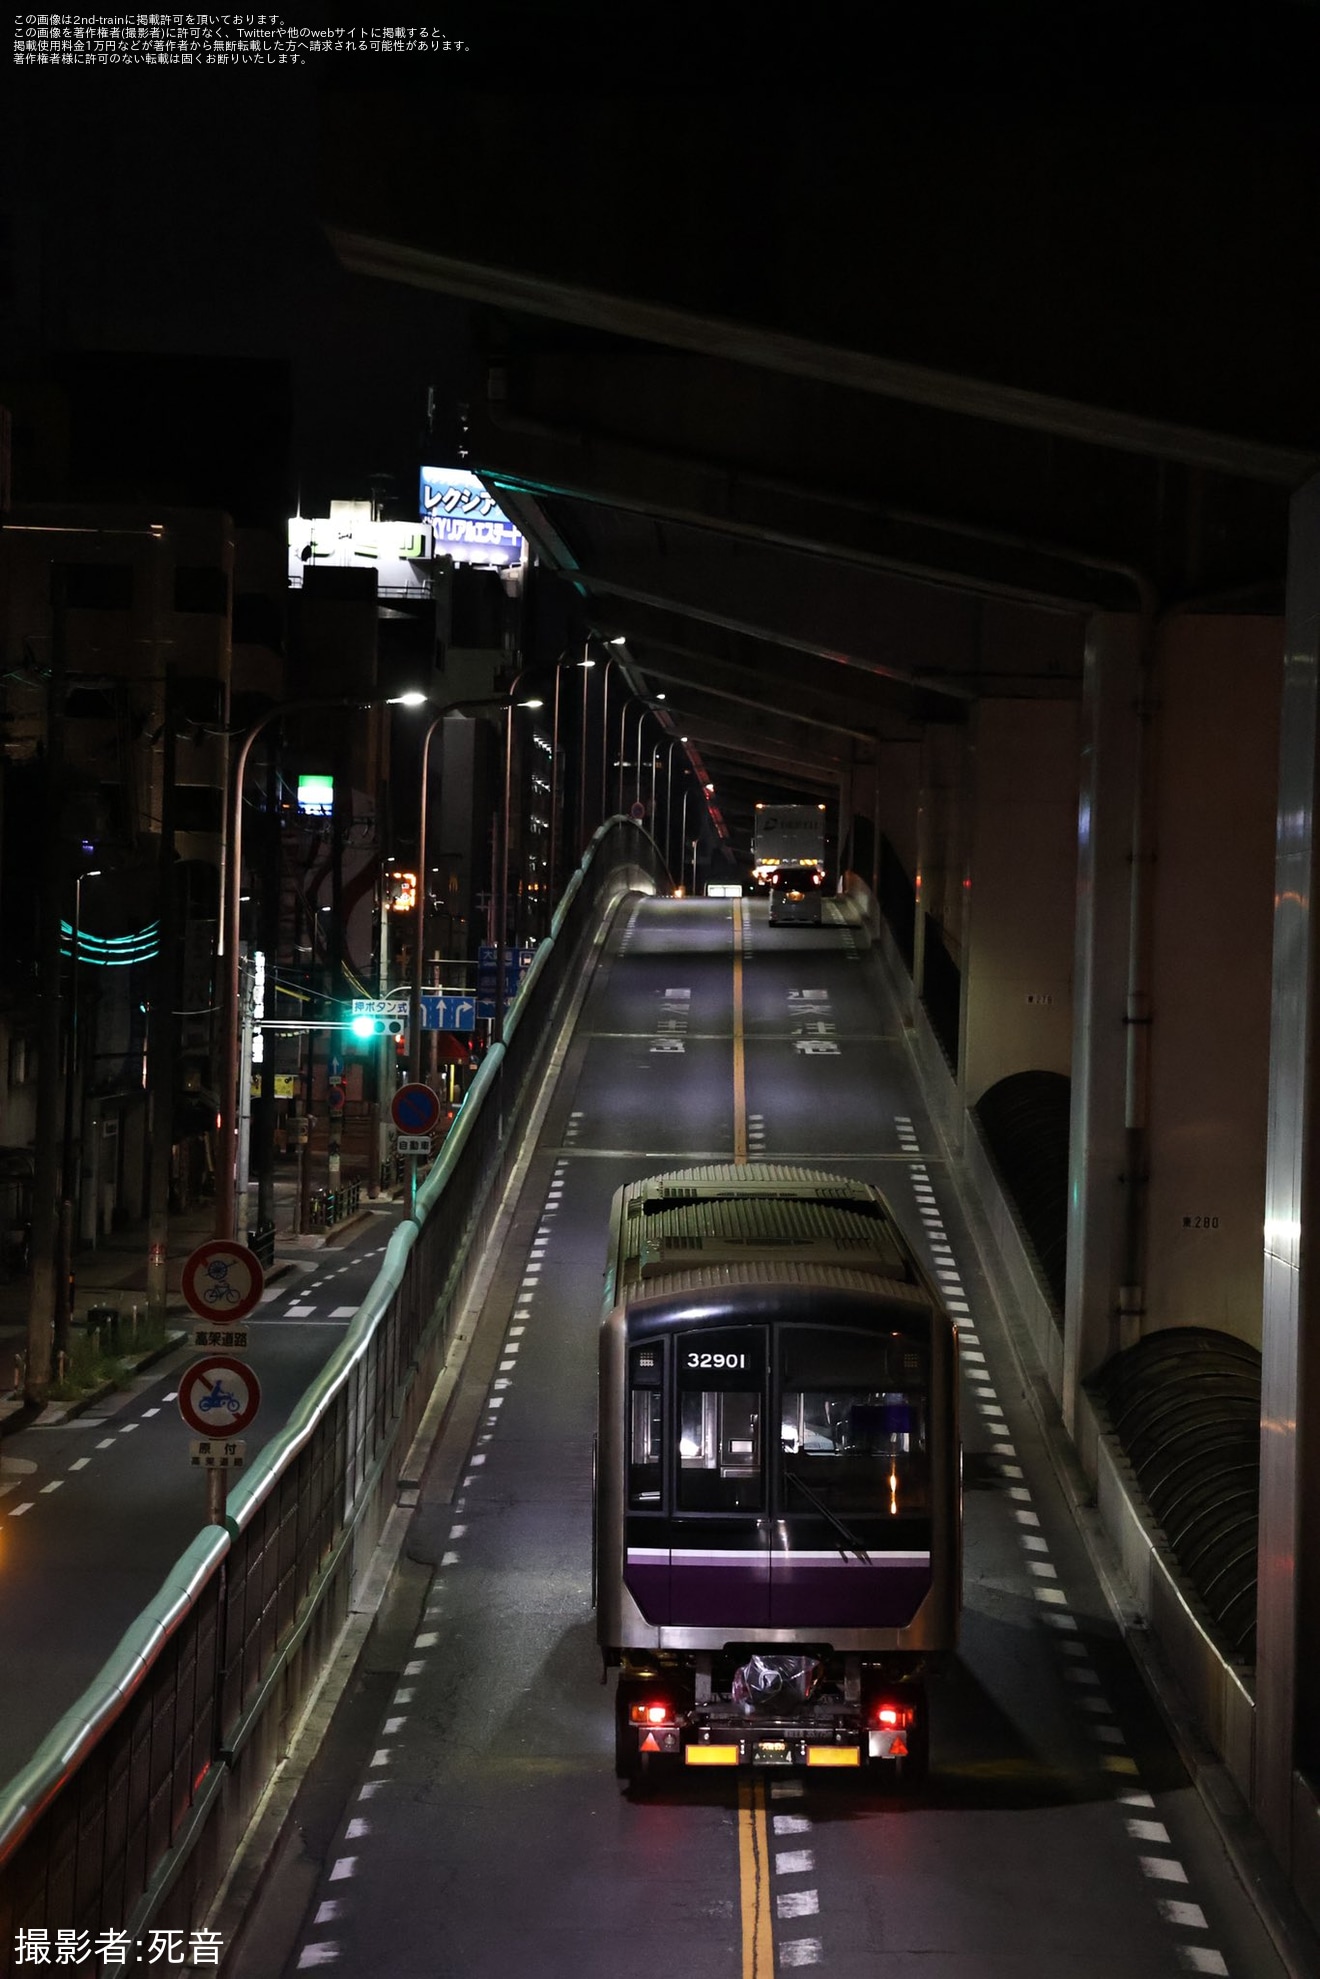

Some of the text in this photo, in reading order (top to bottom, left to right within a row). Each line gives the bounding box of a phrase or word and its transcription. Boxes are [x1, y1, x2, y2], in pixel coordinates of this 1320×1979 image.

[354, 1001, 408, 1013] 押ボタン式
[399, 1139, 430, 1150] 自動車
[195, 1331, 247, 1347] 高架道路
[687, 1352, 745, 1369] 32901
[198, 1443, 237, 1455] 原付
